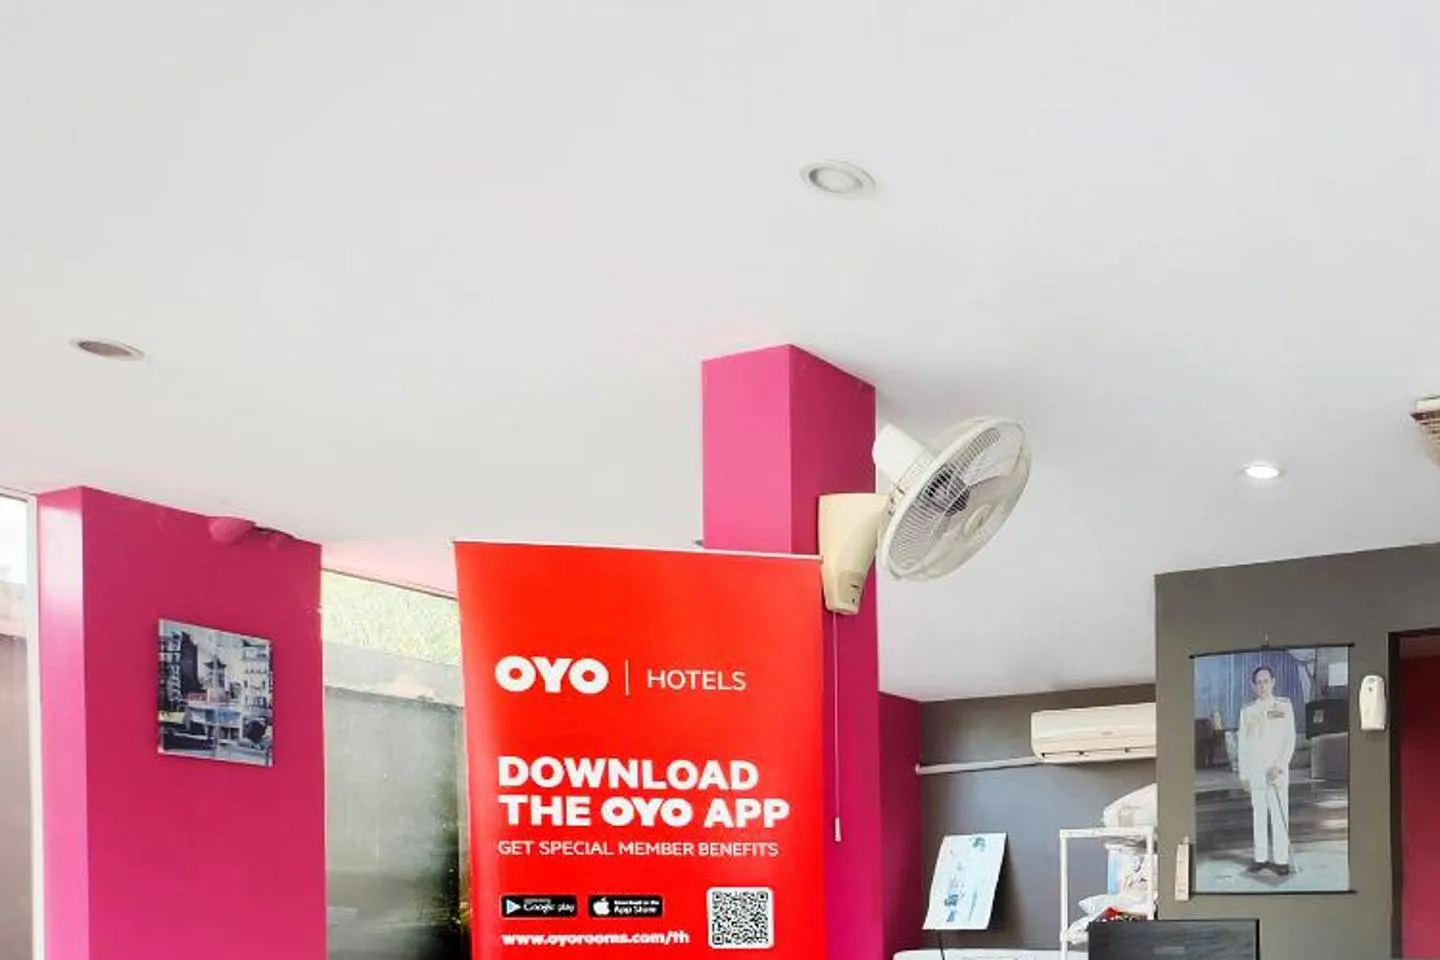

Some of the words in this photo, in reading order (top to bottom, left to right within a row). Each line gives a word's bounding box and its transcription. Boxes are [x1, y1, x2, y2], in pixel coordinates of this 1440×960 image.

[495, 656, 609, 694] OYO
[647, 669, 747, 691] HOTELS
[498, 756, 759, 790] DOWNLOAD
[498, 794, 592, 826] THE
[600, 796, 693, 827] OYO
[703, 798, 791, 828] APP
[498, 840, 535, 856] GET
[539, 840, 613, 856] SPECIAL
[618, 841, 694, 857] MEMBER
[698, 842, 779, 857] BENEFITS
[502, 930, 690, 947] www.oyorooms.com/th
